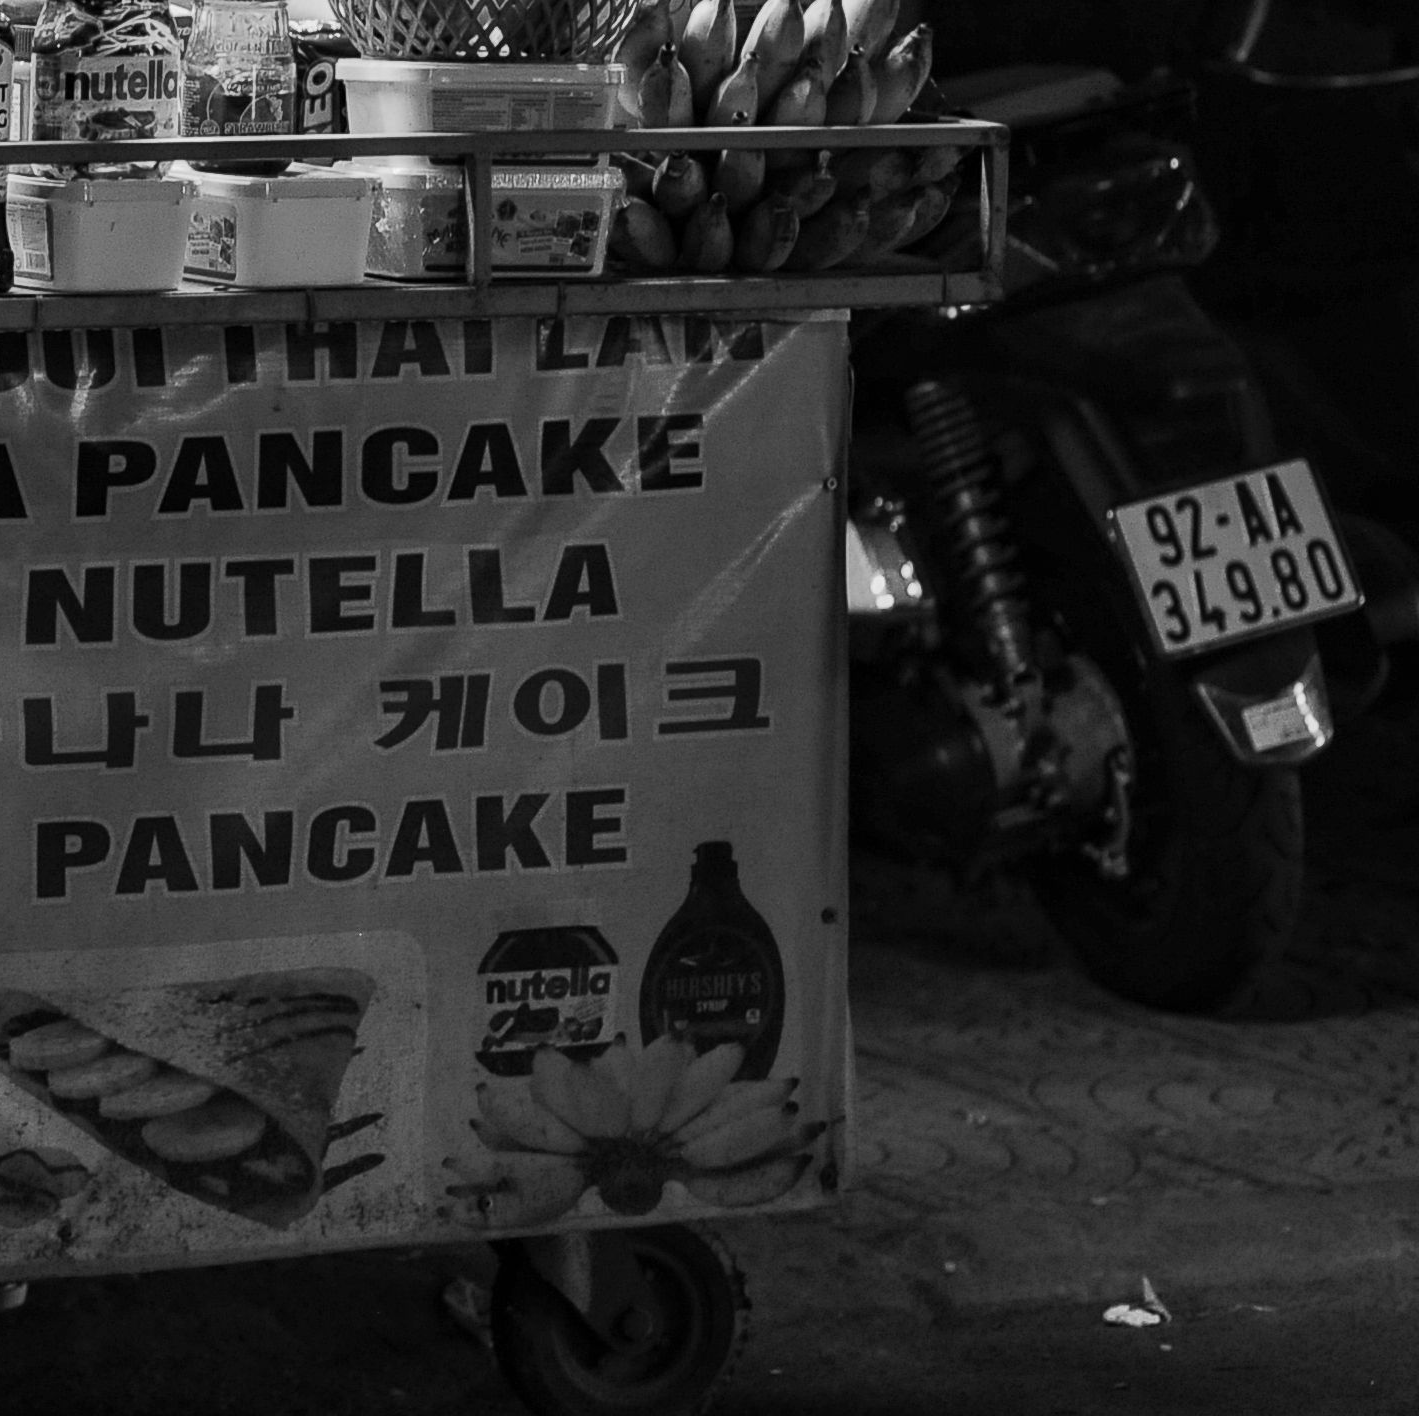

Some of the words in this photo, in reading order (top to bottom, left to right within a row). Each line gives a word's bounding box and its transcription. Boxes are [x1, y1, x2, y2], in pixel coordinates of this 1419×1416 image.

[64, 59, 180, 101] nutella
[75, 413, 705, 518] PANCAKE
[1145, 473, 1303, 566] 92-AA
[25, 543, 619, 647] NUTELLA
[1151, 539, 1343, 642] 349.80
[373, 658, 771, 751] 케이크
[35, 788, 628, 899] PANCAKE
[486, 964, 611, 1004] nutella
